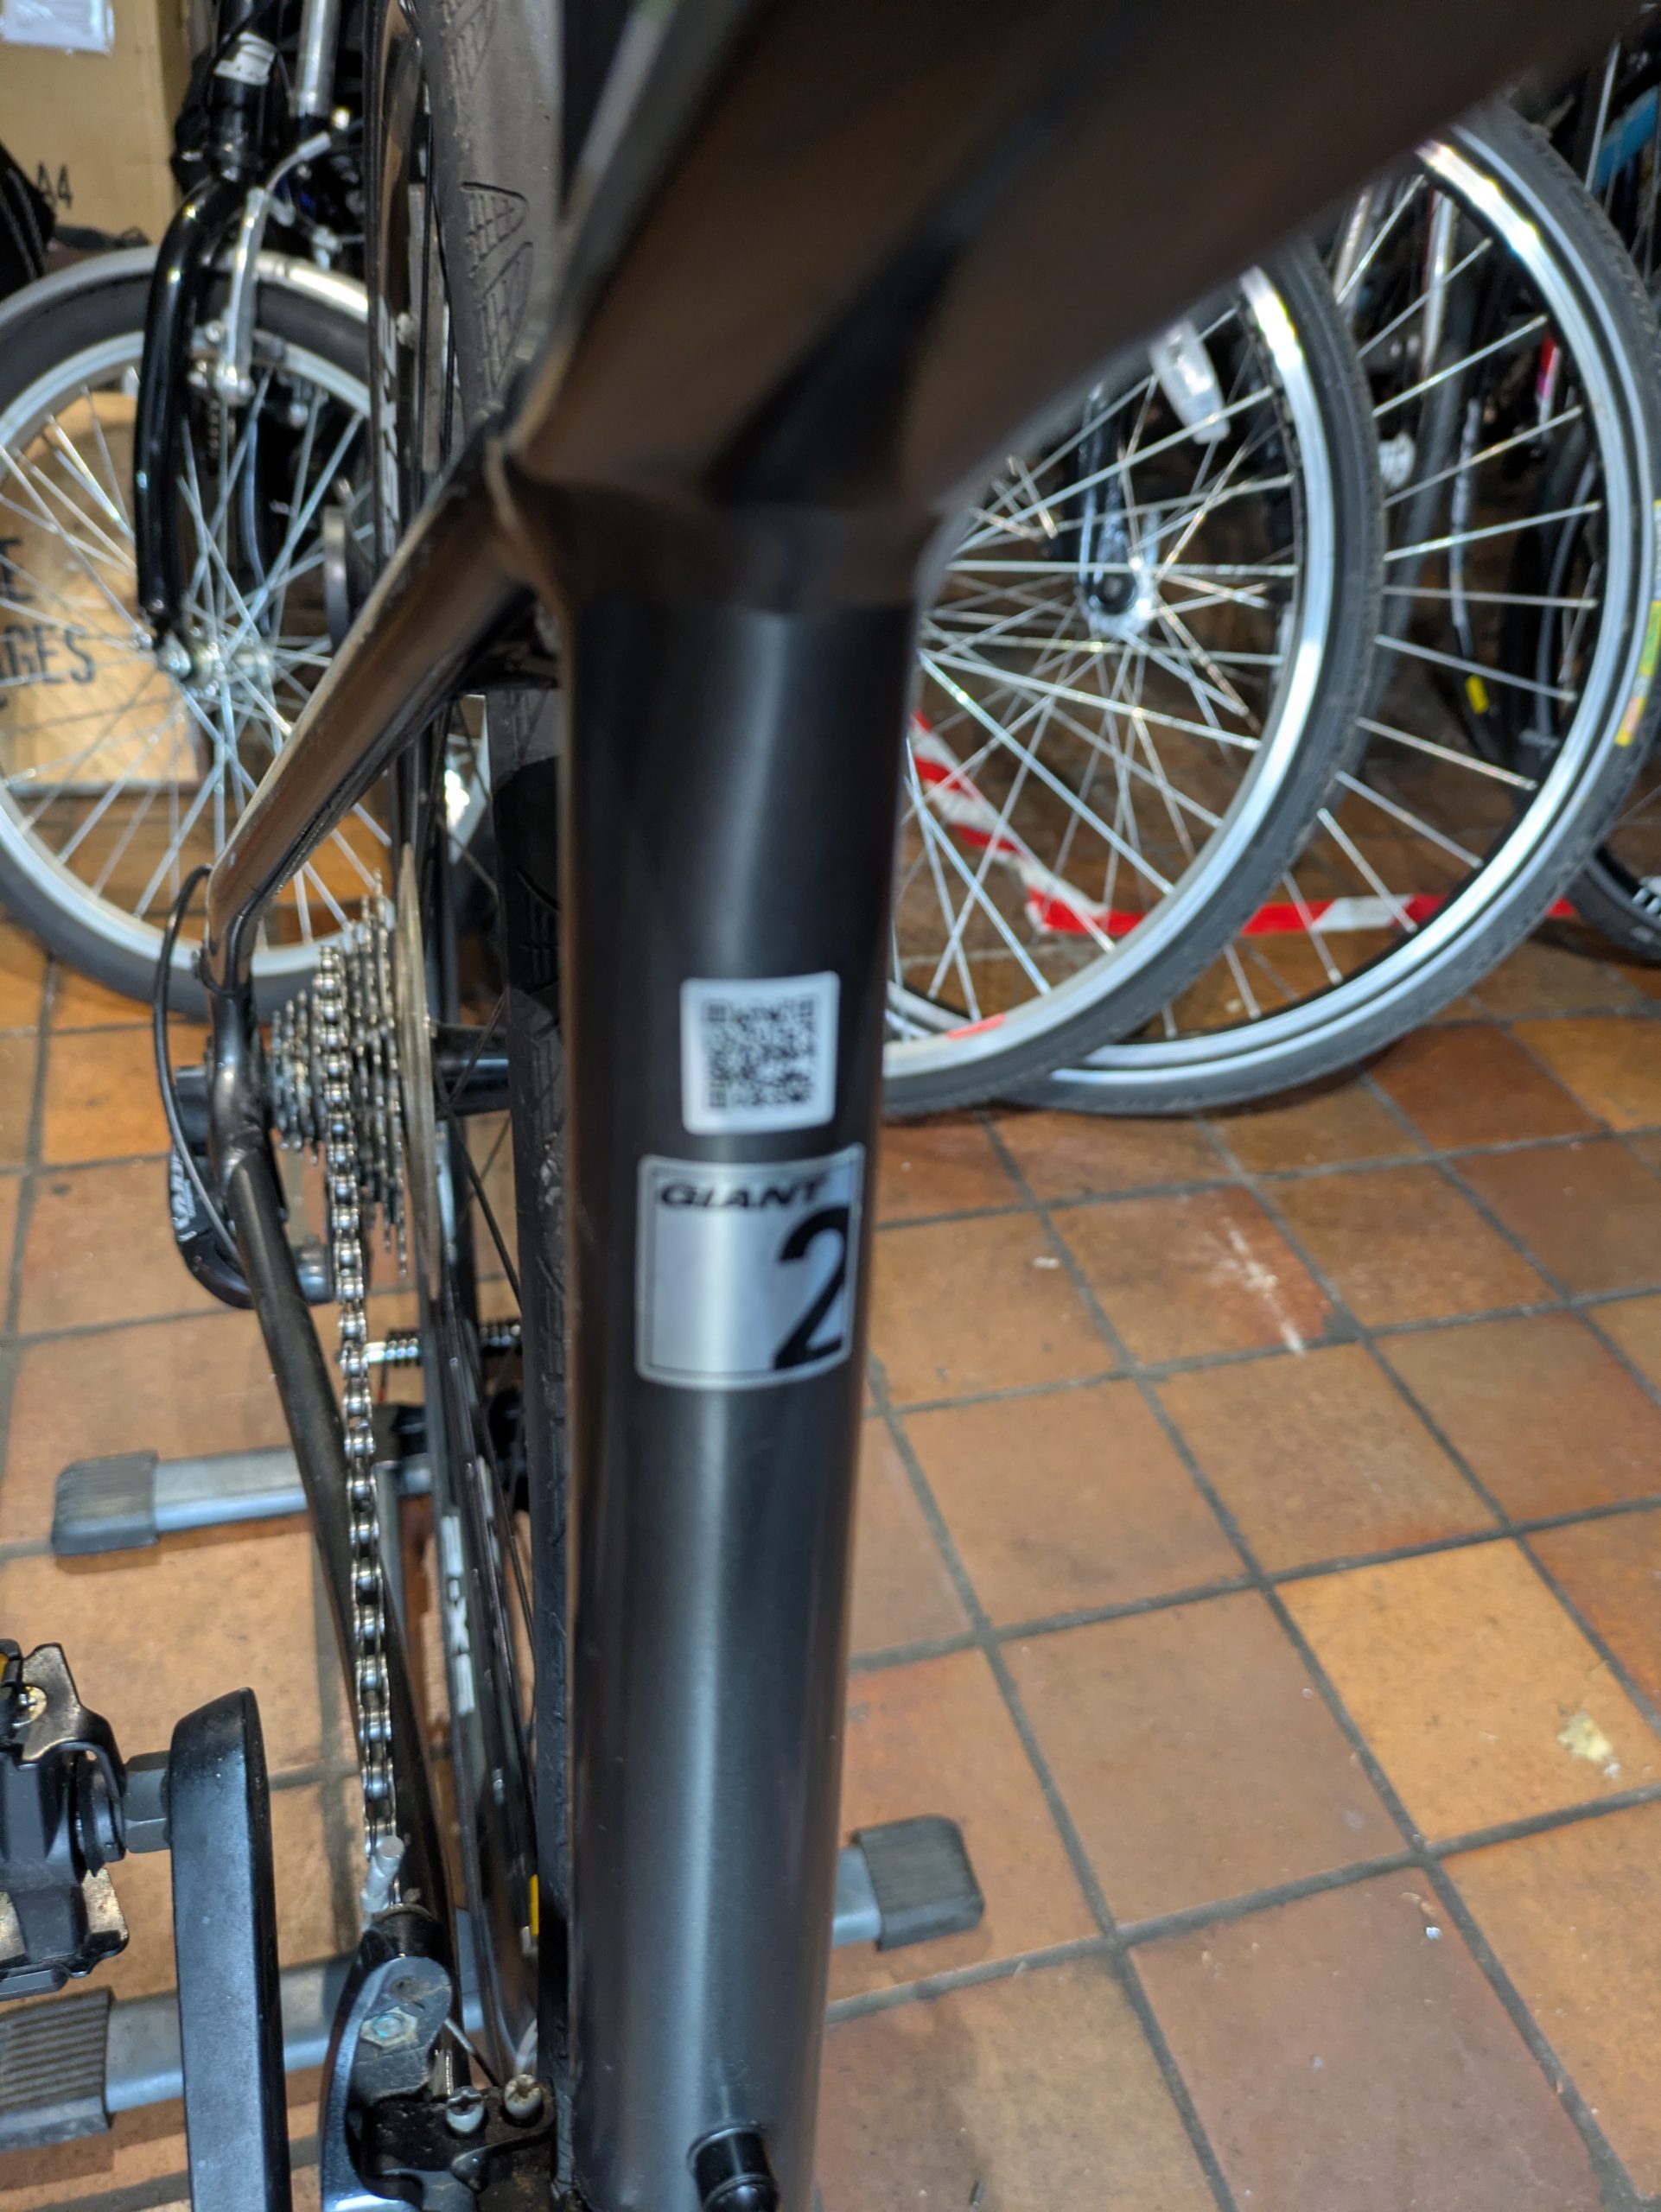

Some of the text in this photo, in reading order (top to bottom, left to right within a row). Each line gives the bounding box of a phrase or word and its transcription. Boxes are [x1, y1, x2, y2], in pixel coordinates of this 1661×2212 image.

[0, 624, 95, 685] GES
[659, 1170, 830, 1208] GIANT
[772, 1206, 849, 1370] 2
